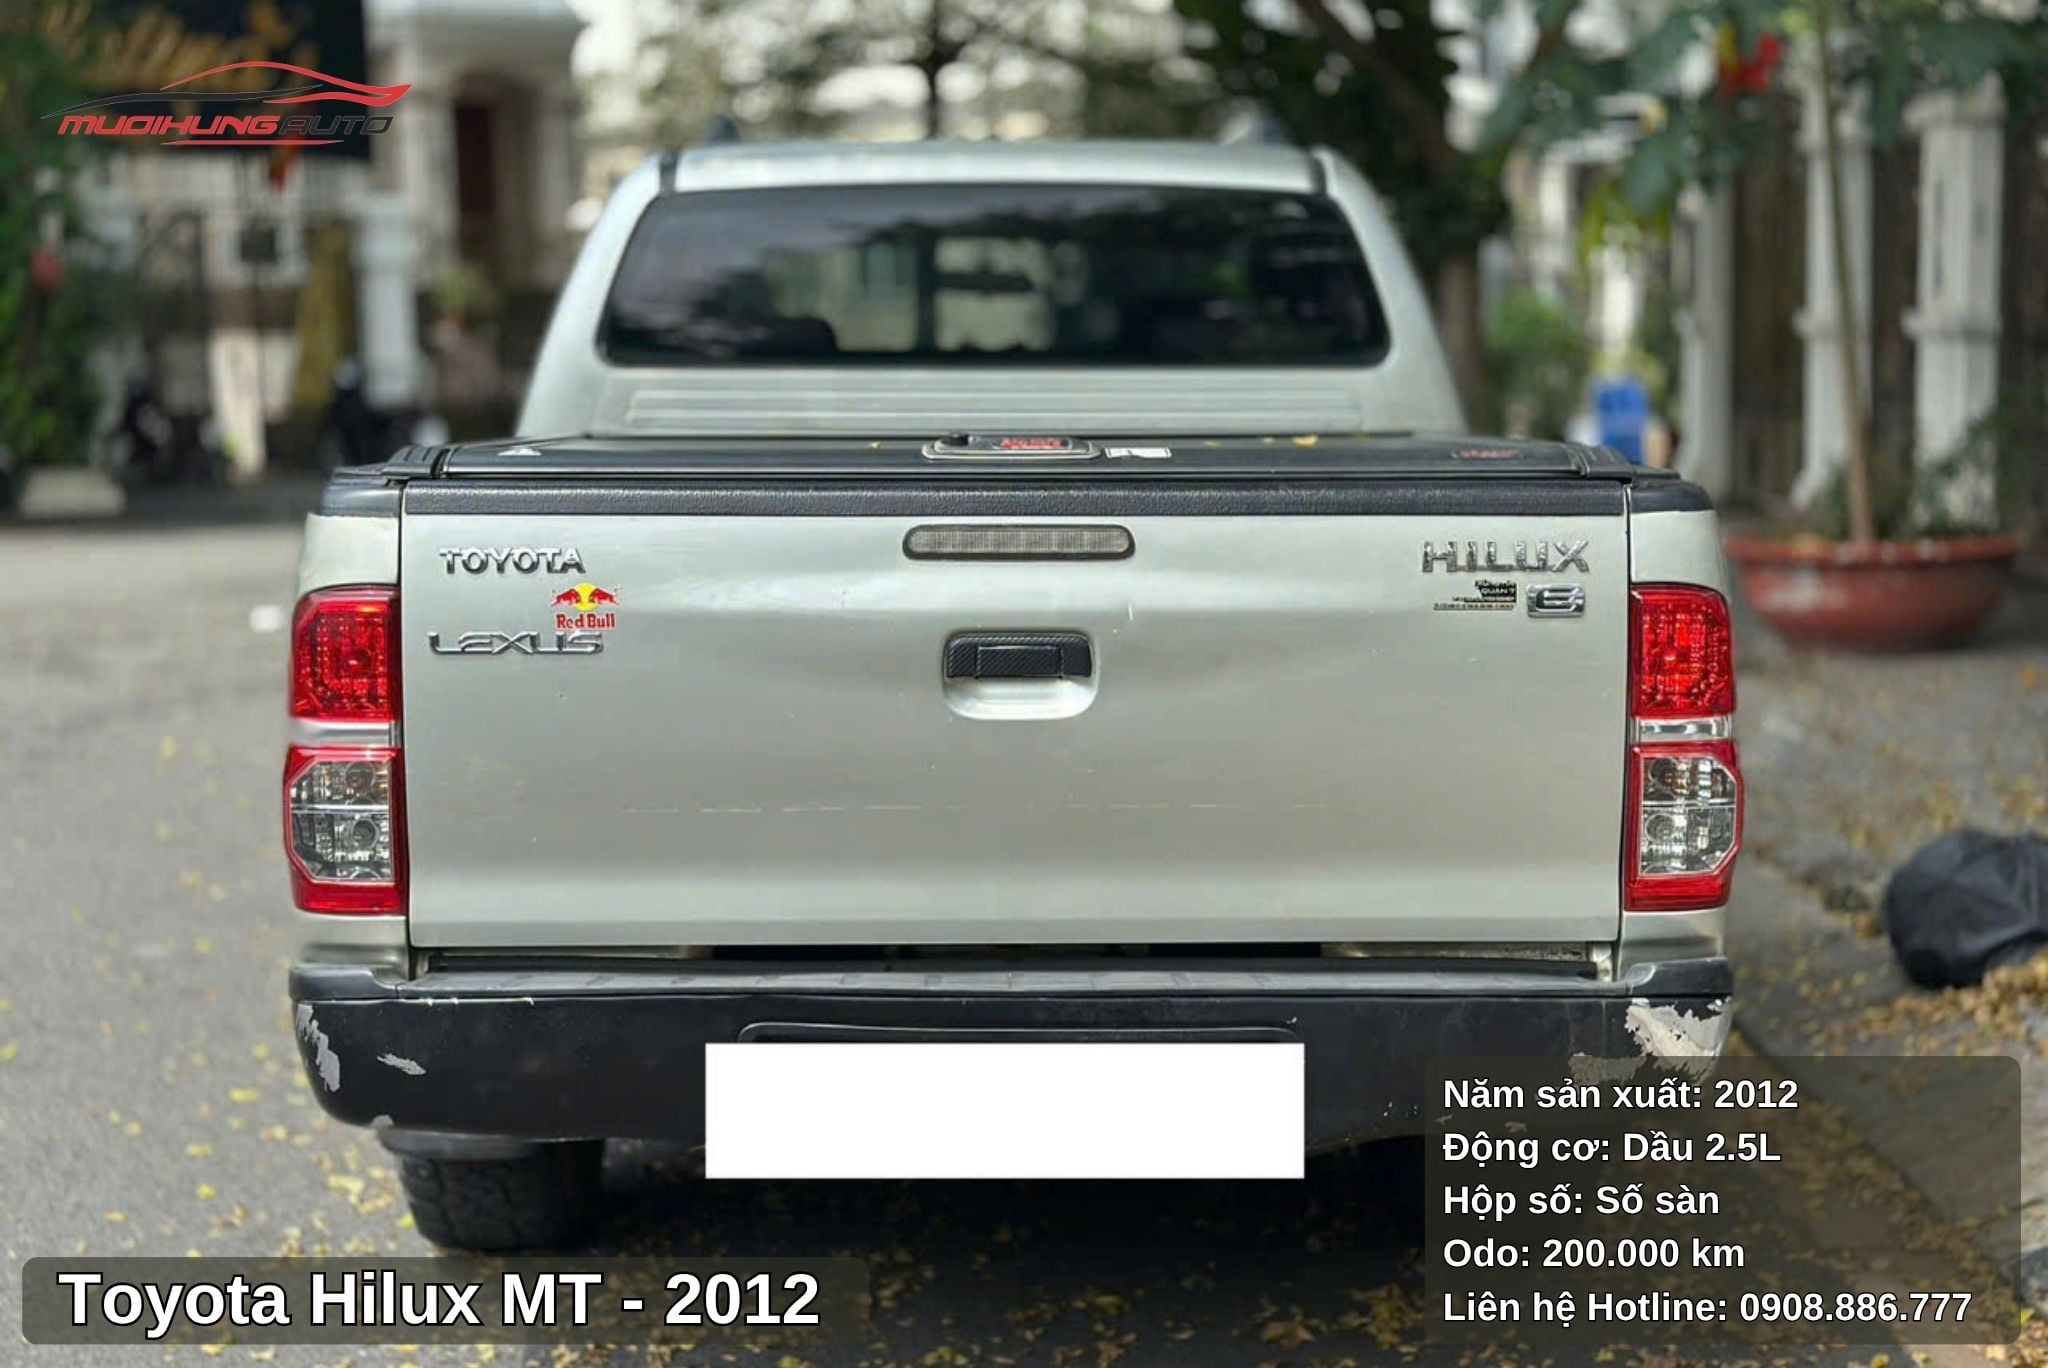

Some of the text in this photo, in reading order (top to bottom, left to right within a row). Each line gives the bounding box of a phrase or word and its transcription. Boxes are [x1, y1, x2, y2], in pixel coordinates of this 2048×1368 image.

[440, 547, 586, 574] TOYOTA
[1421, 540, 1590, 573] HILUX
[556, 613, 616, 629] Red Bull
[428, 631, 603, 654] LEXUS
